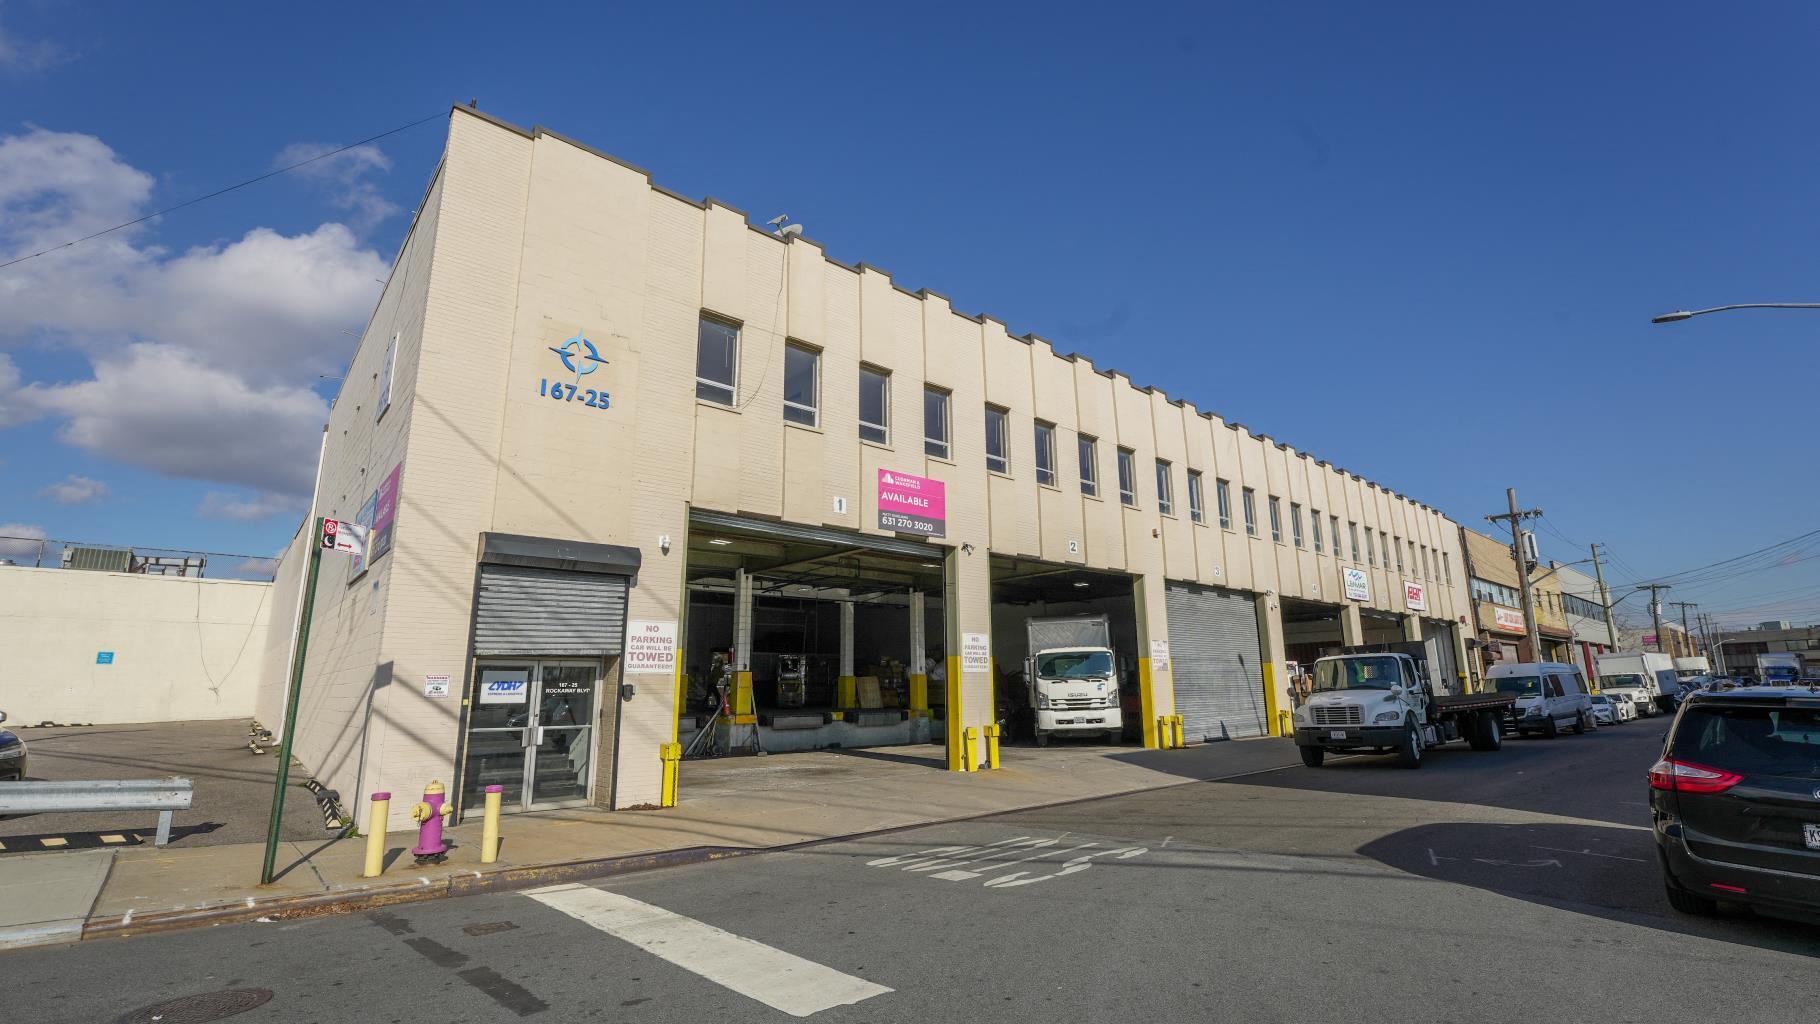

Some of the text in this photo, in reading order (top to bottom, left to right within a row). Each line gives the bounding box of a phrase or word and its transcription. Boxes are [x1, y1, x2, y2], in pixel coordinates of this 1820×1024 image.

[540, 378, 610, 410] 167-25
[838, 498, 843, 511] 1
[881, 491, 929, 508] AVAILABLE
[882, 516, 933, 531] 631 270 3020
[1070, 542, 1077, 552] 2
[631, 635, 673, 644] PARKING
[628, 651, 674, 662] TOWED
